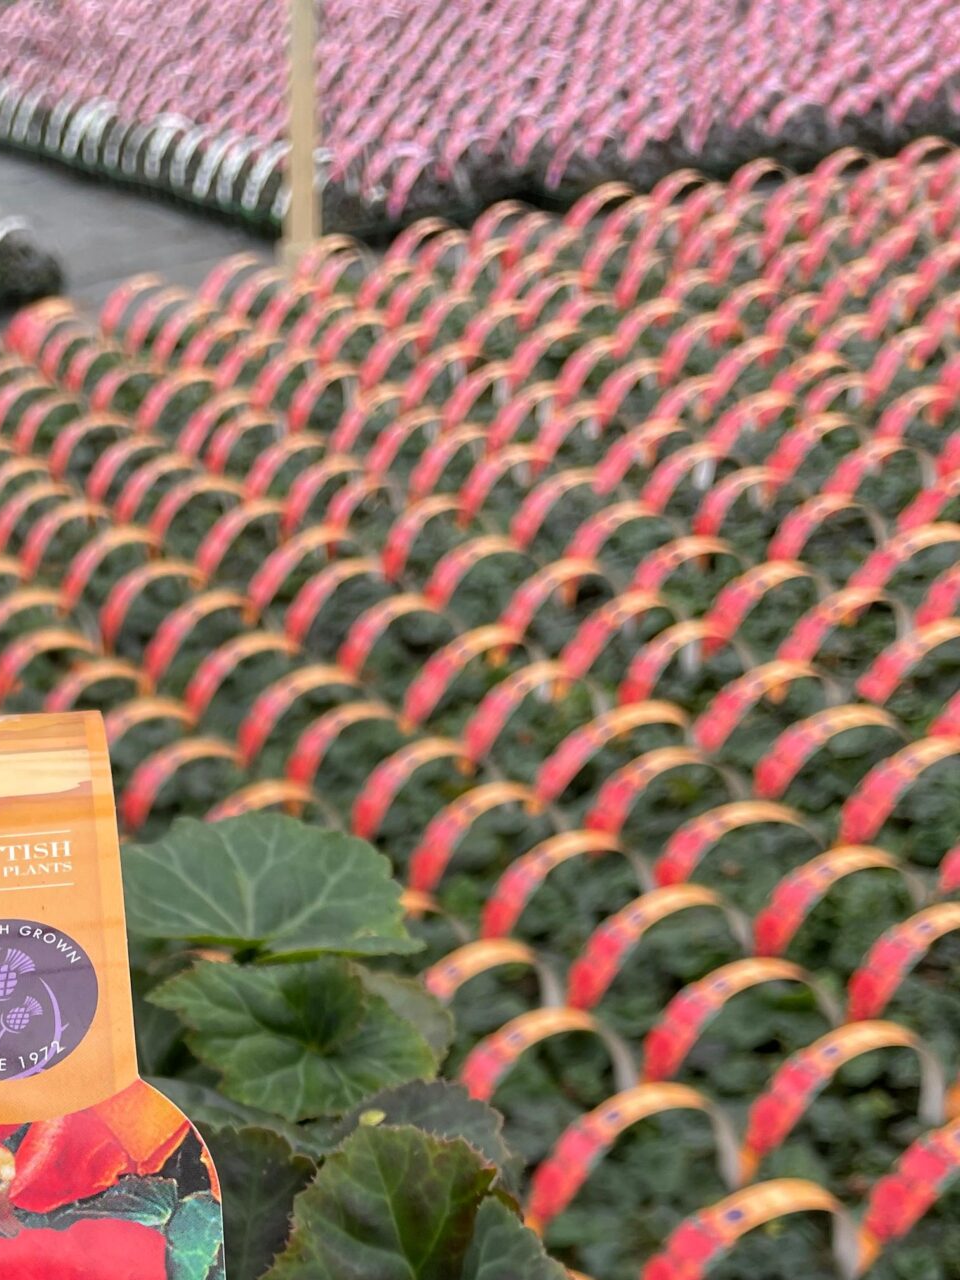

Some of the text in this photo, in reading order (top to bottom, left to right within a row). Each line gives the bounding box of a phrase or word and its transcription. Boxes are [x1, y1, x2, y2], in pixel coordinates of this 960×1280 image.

[3, 861, 73, 878] PLANTS
[19, 925, 81, 964] GROWN
[18, 1040, 66, 1069] 1972
